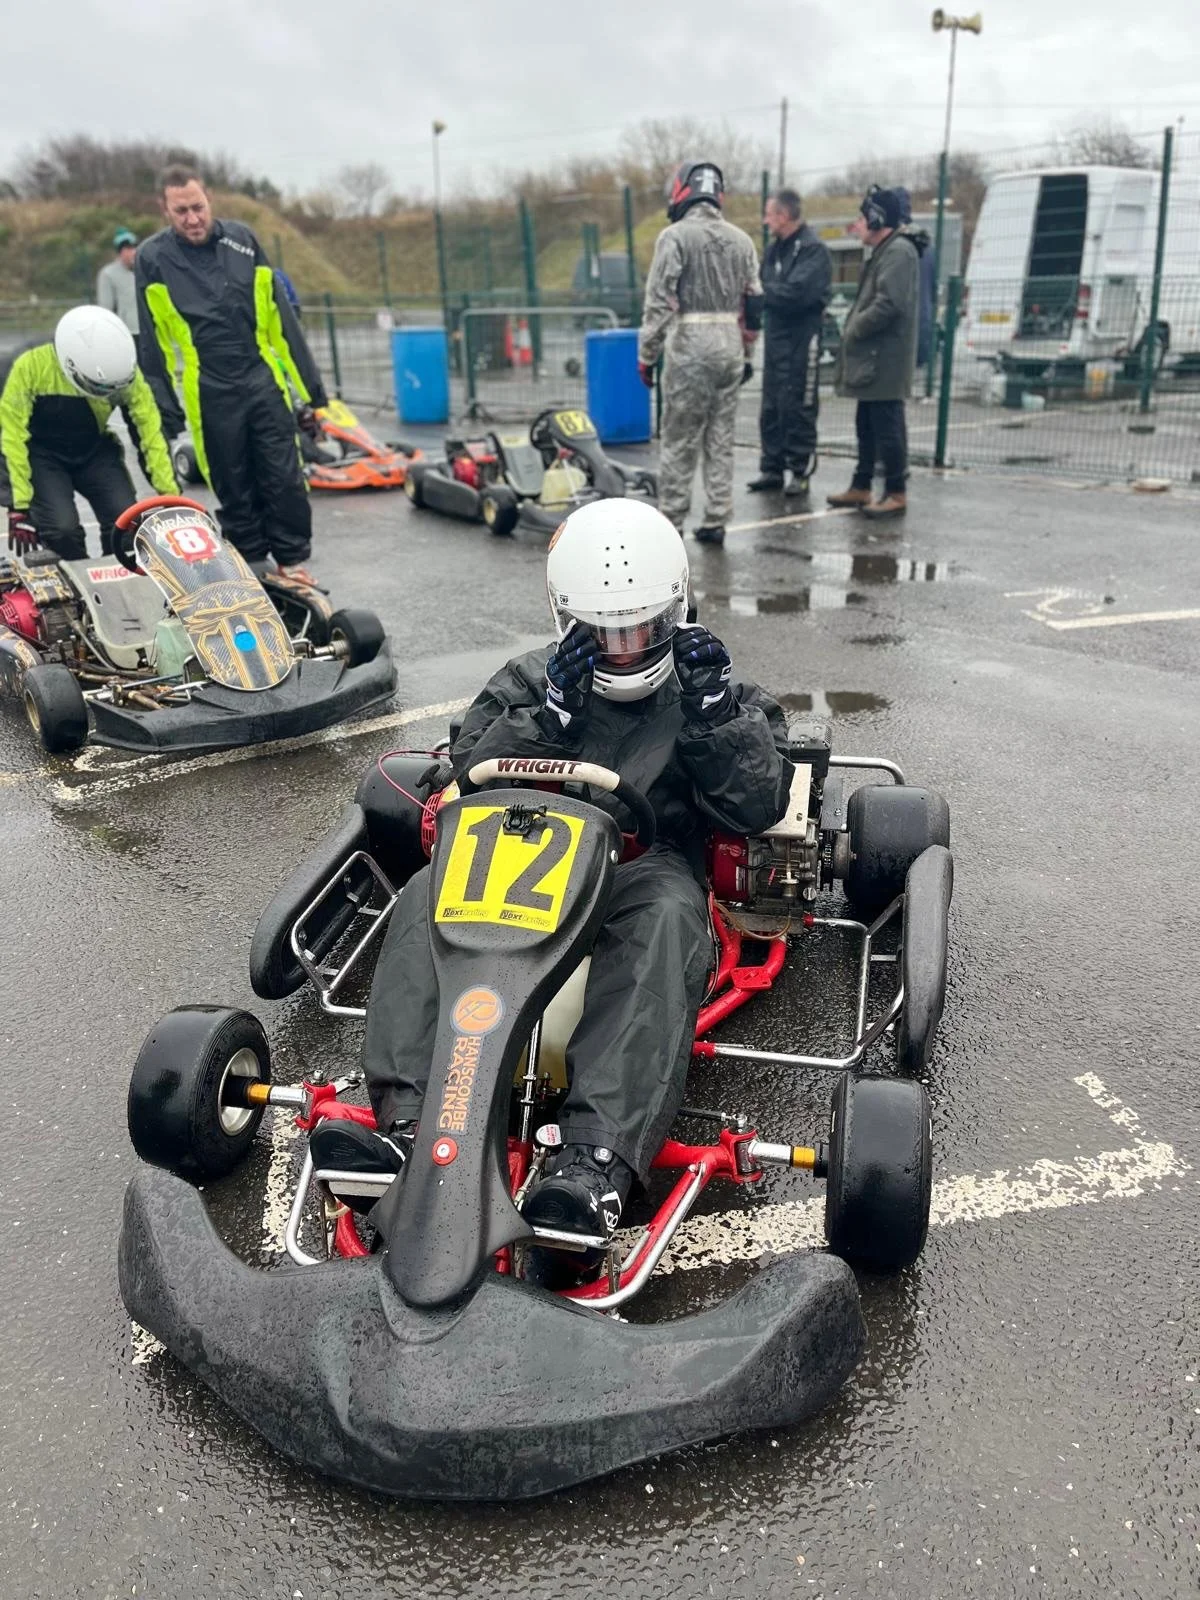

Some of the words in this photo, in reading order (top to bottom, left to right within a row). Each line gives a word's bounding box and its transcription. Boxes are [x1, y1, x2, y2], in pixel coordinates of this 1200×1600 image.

[173, 528, 207, 554] 8
[90, 567, 129, 580] WRIG
[497, 759, 581, 775] WRIGHT
[463, 811, 572, 912] 12
[439, 1036, 468, 1129] RACING
[451, 1036, 482, 1131] HANSCOMBE
